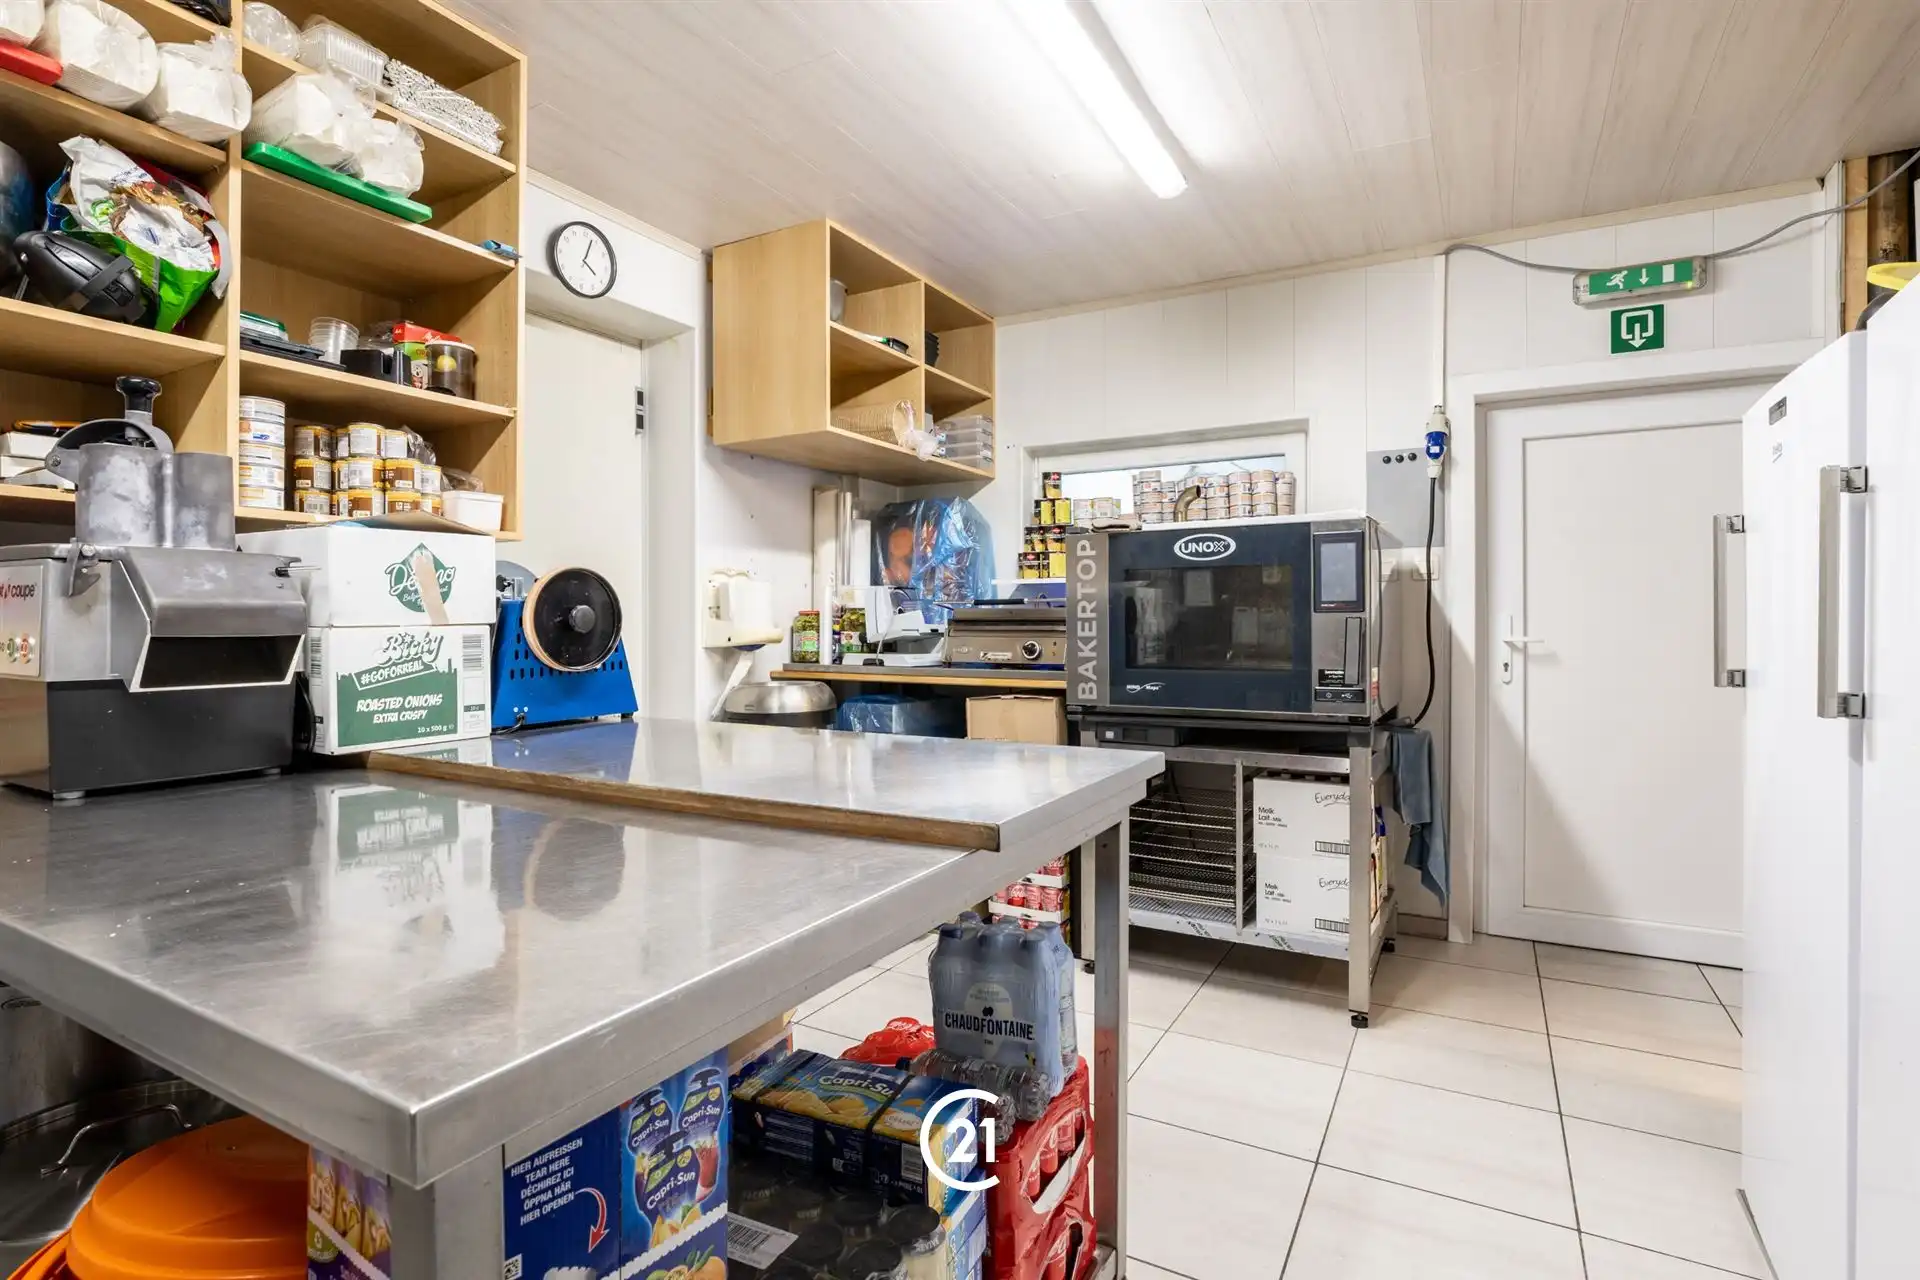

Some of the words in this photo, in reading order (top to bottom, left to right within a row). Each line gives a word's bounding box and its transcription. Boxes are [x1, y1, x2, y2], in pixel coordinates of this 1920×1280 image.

[1181, 541, 1225, 553] UNOX
[11, 584, 35, 600] coupe
[1077, 539, 1097, 700] BAKERTOP
[379, 631, 444, 665] Bicky
[360, 659, 425, 685] #GOFORREAL
[356, 697, 404, 712] ROASTED
[404, 693, 443, 708] ONIONS
[373, 712, 399, 724] EXTRA
[399, 710, 428, 721] CRISPY
[945, 1012, 1033, 1041] CHAUDFONTAINE
[820, 1075, 900, 1098] Capri-Su
[681, 1104, 720, 1128] Capri-Sun
[632, 1119, 669, 1147] Capri-Sun
[511, 1160, 532, 1177] HIER
[533, 1138, 583, 1168] AUFREISSEN
[525, 1167, 547, 1183] TEAR
[549, 1156, 571, 1173] HERE
[521, 1173, 561, 1199] DÉCHIREZ
[563, 1167, 574, 1178] ICI
[524, 1190, 552, 1211] ÖPPNA
[554, 1181, 571, 1198] HÄR
[646, 1171, 696, 1209] Capri-Sun
[520, 1209, 540, 1226] HIER
[542, 1192, 574, 1214] OPENEN
